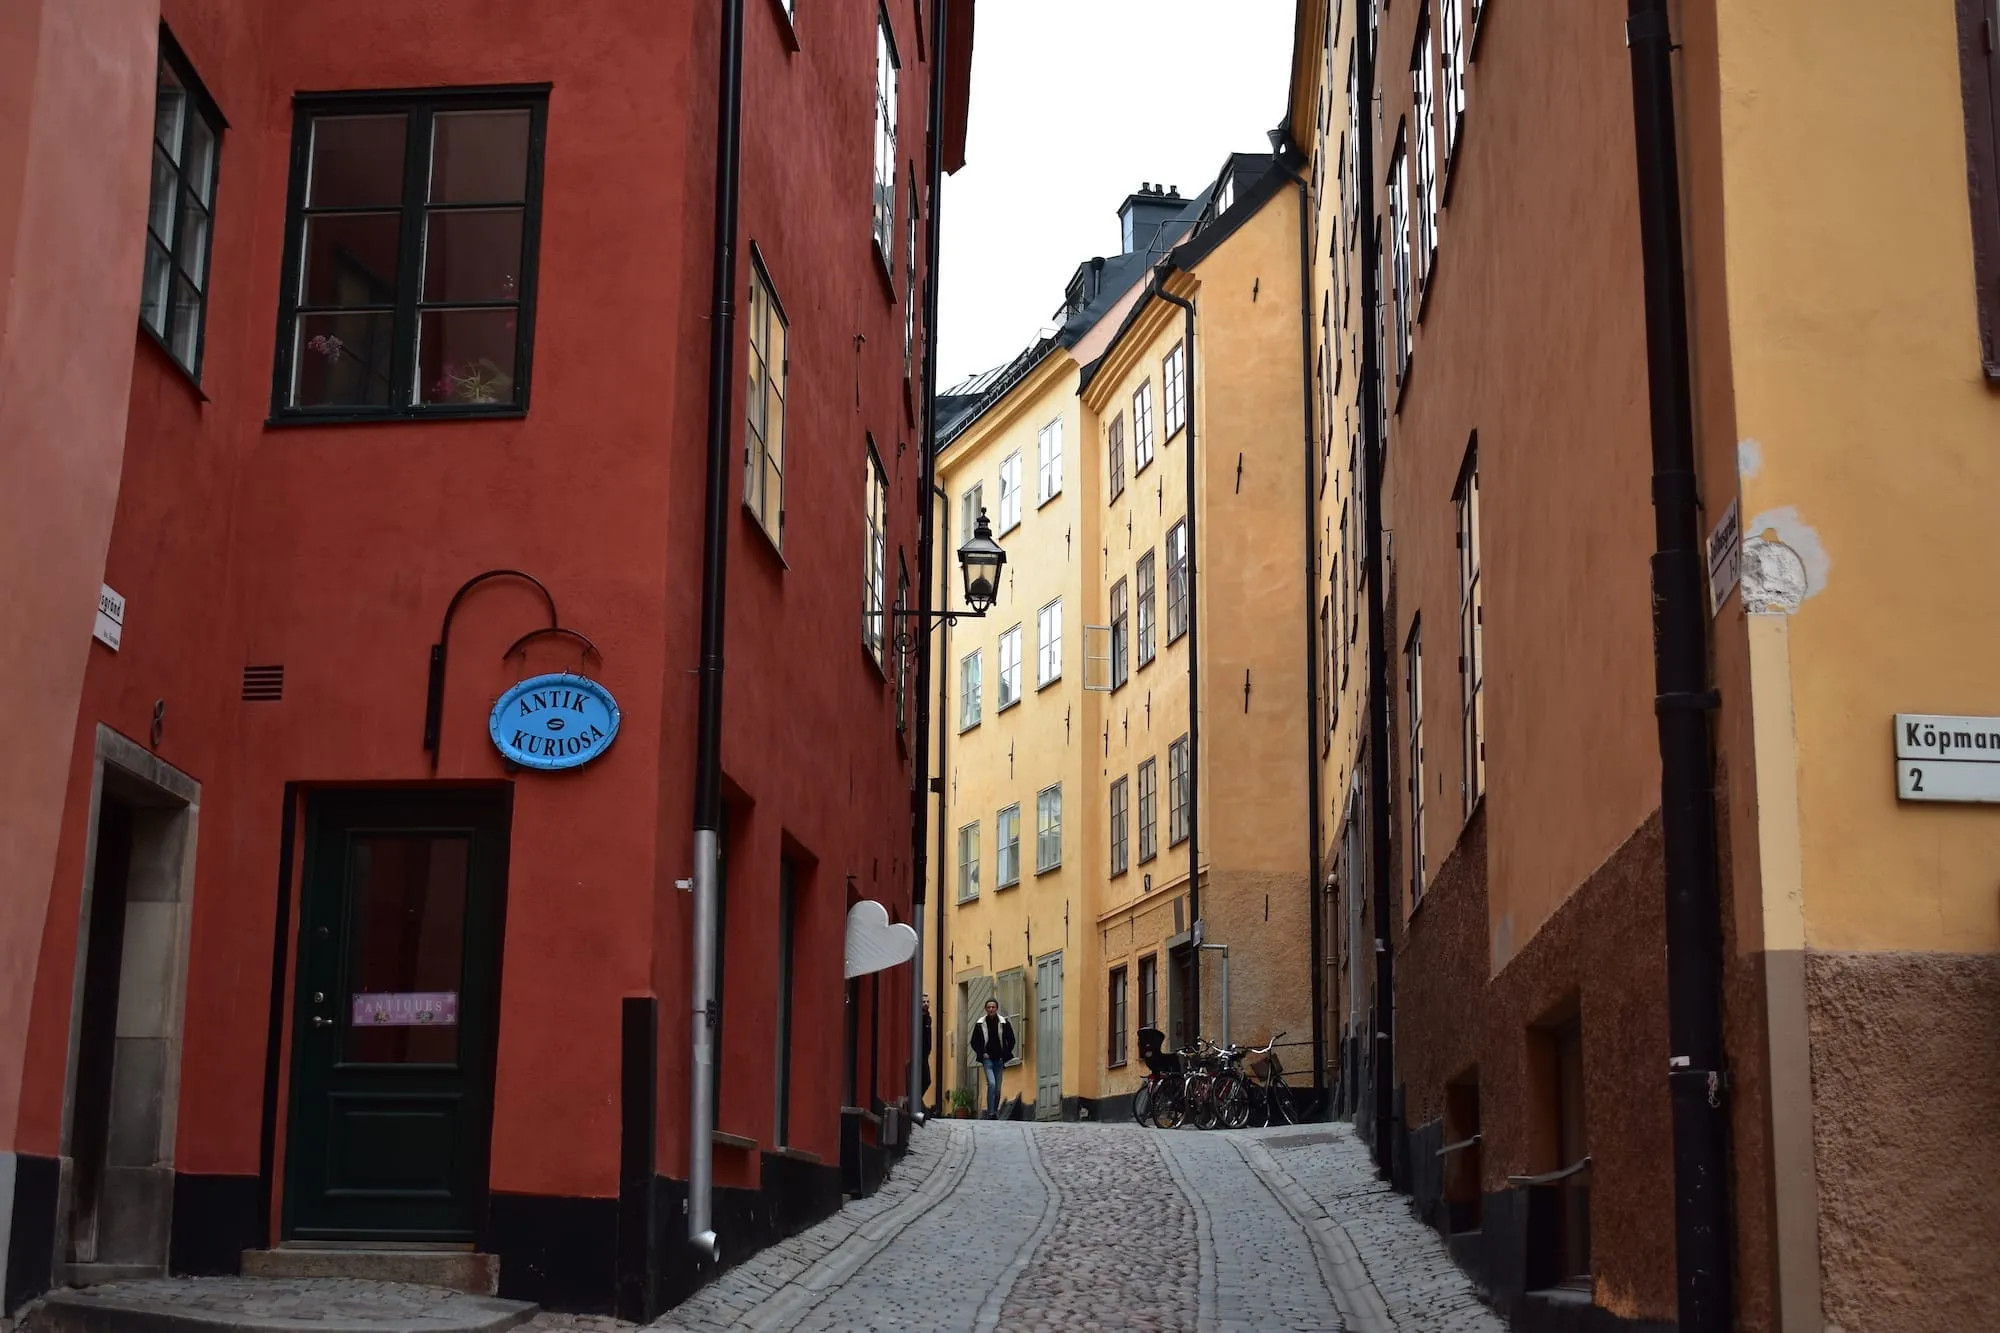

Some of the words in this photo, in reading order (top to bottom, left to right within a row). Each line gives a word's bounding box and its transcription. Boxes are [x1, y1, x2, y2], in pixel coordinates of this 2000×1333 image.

[100, 594, 122, 618] sgränd
[520, 690, 591, 717] ANTIK
[510, 724, 605, 757] KURIOSA
[1906, 722, 2000, 755] Köpman
[1909, 767, 1924, 792] 2
[364, 999, 443, 1014] ANTIQUES
